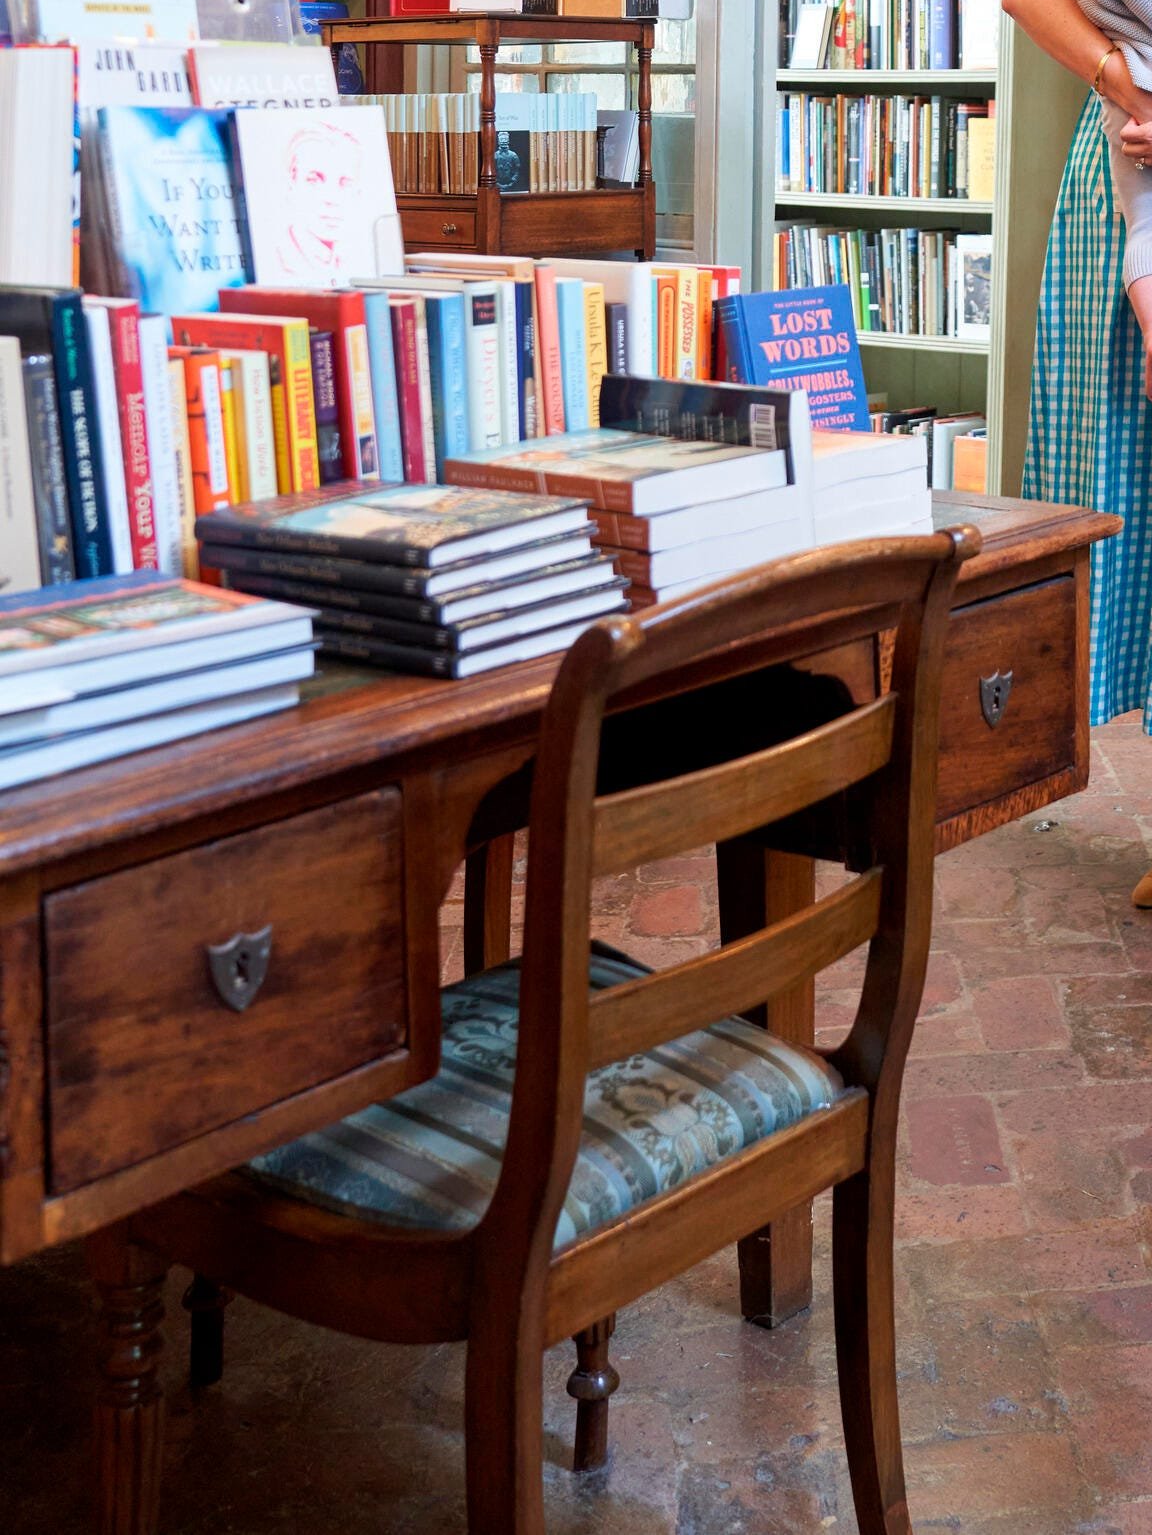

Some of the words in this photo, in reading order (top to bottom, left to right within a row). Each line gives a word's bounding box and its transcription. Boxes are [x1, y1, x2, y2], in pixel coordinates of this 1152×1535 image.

[95, 49, 136, 72] JOHN
[208, 75, 329, 98] WALLACE
[685, 279, 693, 297] THE
[587, 291, 602, 338] Ursula
[681, 300, 695, 355] POSSESSED
[769, 308, 832, 336] LOST
[617, 319, 625, 349] URSULA
[760, 332, 851, 364] WORDS
[549, 346, 559, 373] THE
[591, 362, 605, 382] Le
[478, 337, 498, 423] Dreyer's
[126, 392, 151, 476] Memoir
[133, 479, 155, 538] Your
